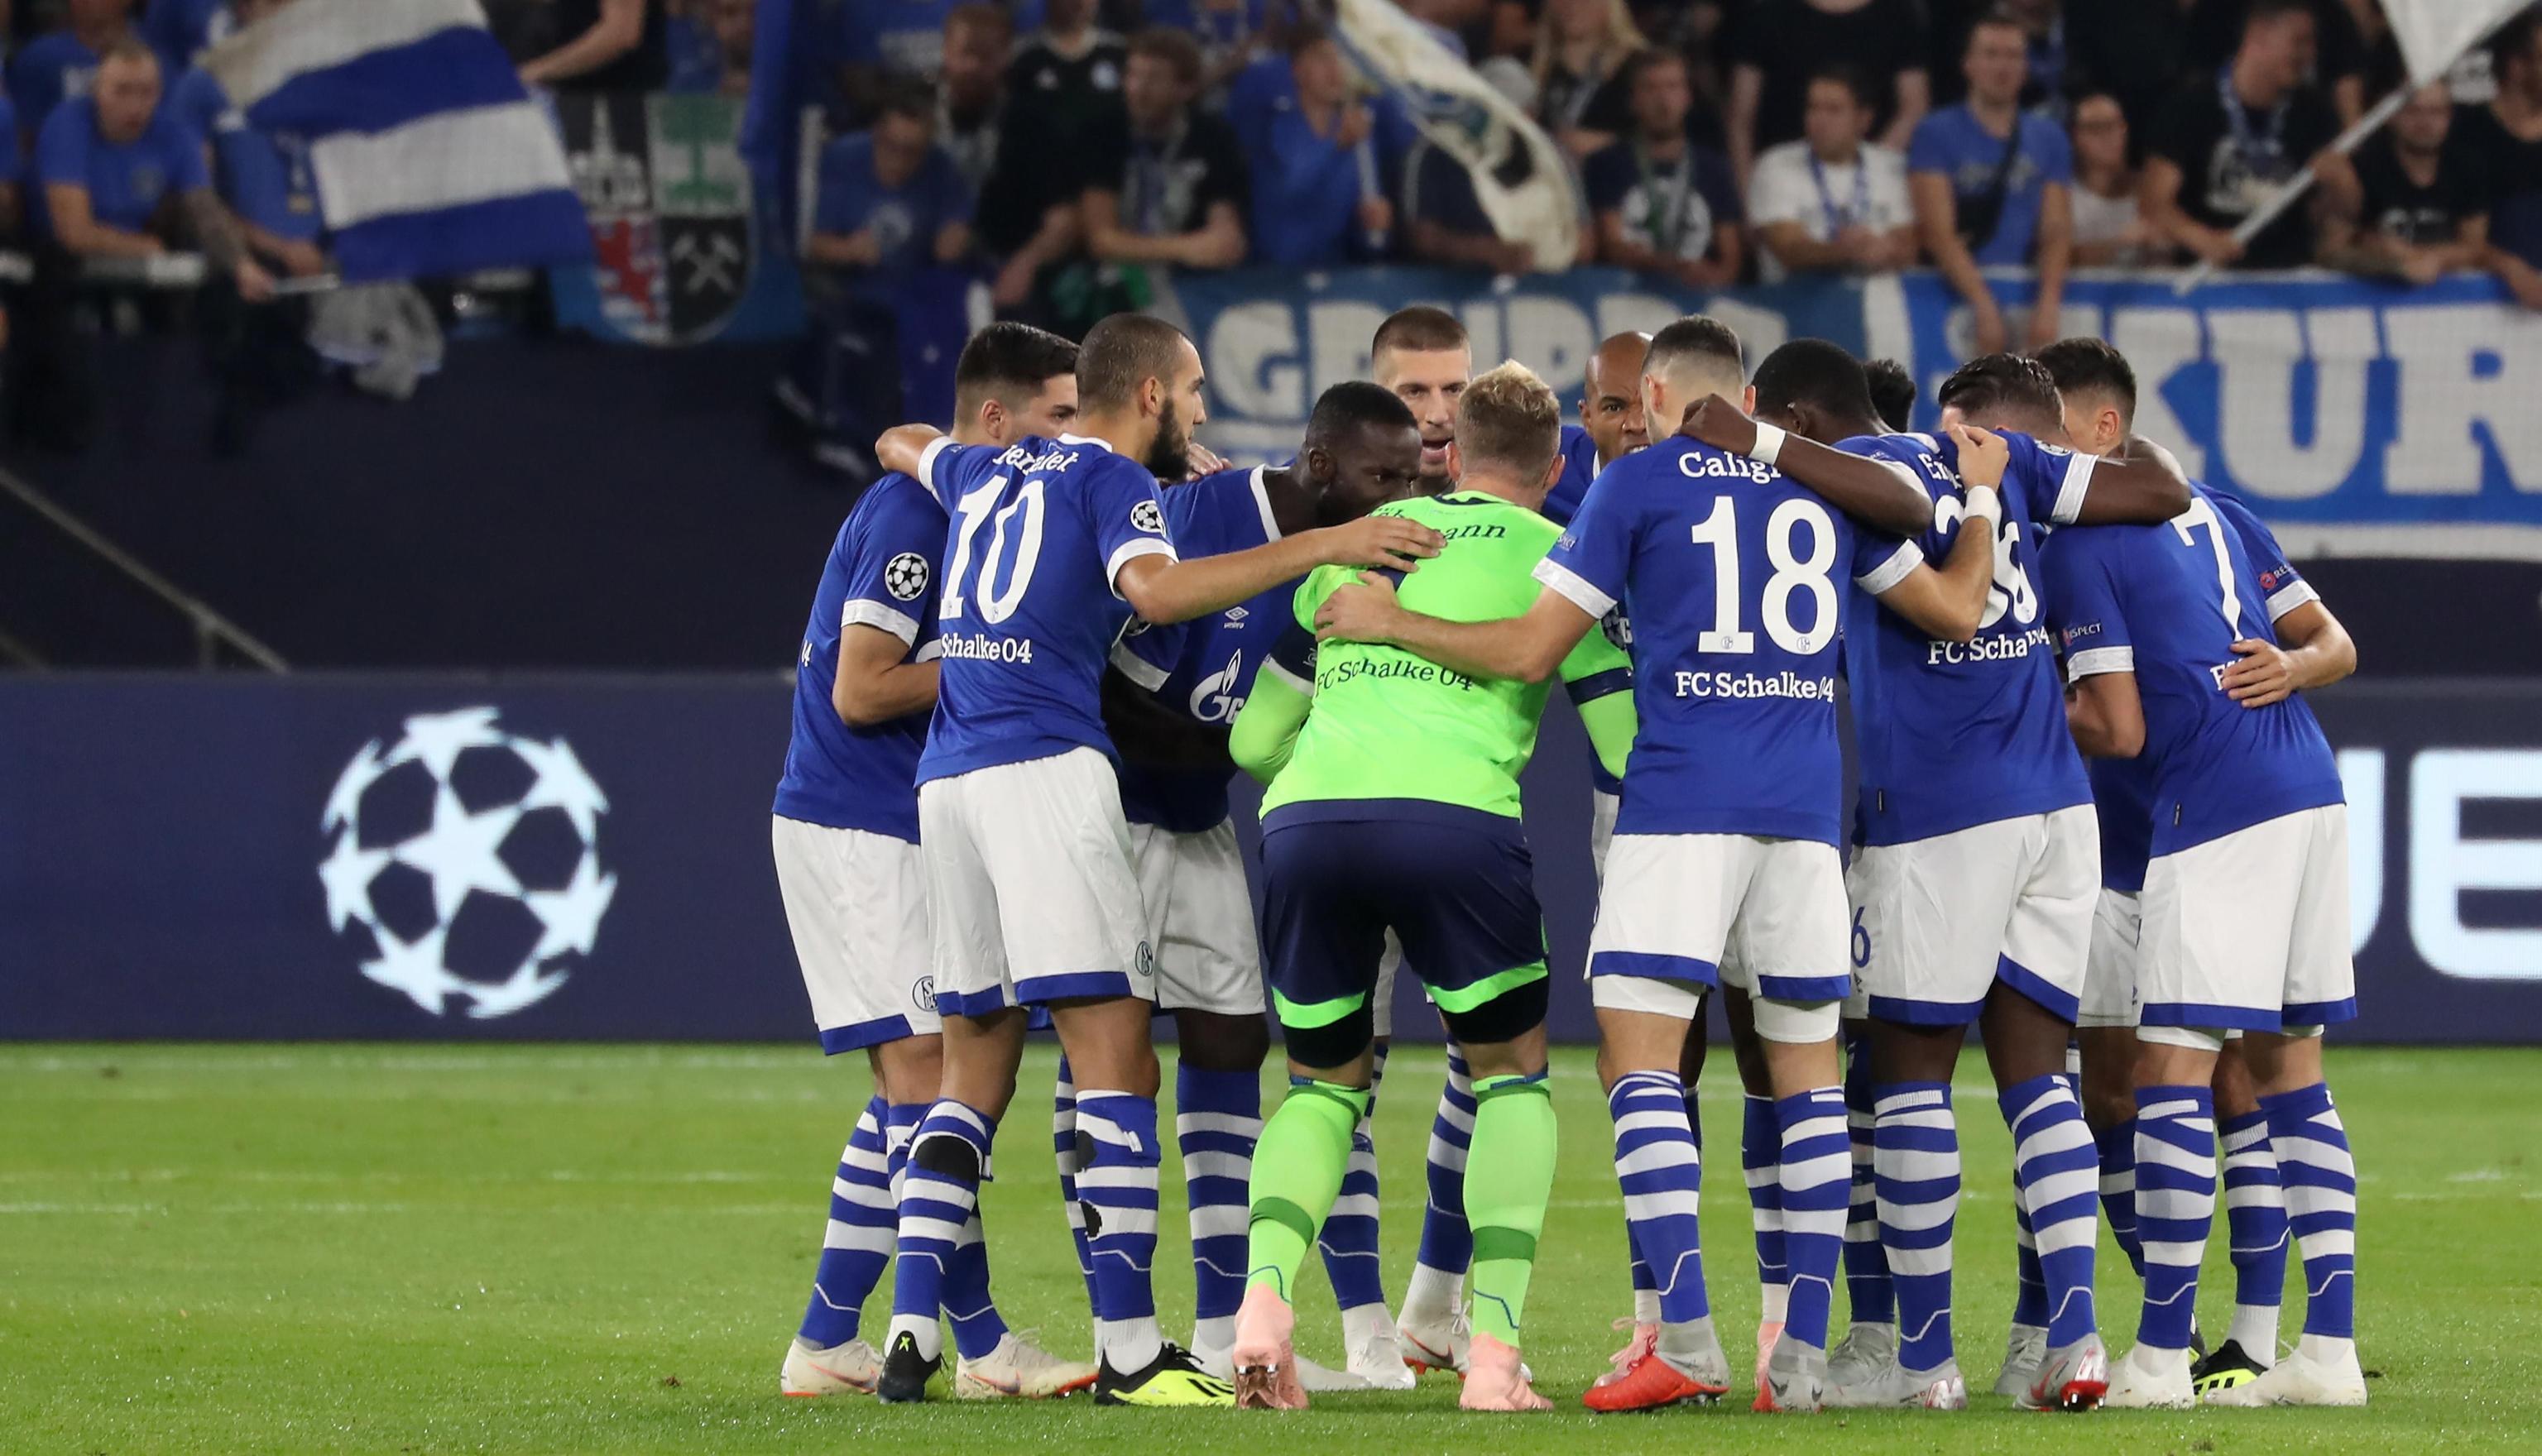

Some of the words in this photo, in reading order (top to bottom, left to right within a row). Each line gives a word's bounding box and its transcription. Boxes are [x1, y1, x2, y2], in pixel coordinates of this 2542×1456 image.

[939, 474, 1045, 625] 10
[2170, 496, 2242, 642] 7
[1691, 496, 1838, 655] 18
[942, 633, 1000, 660] Schalke
[1002, 638, 1033, 663] 04
[1928, 639, 1964, 665] FC
[1316, 667, 1336, 698] FC
[1337, 656, 1434, 683] Schalke
[1674, 670, 1711, 698] FC
[1715, 671, 1818, 699] Schalke
